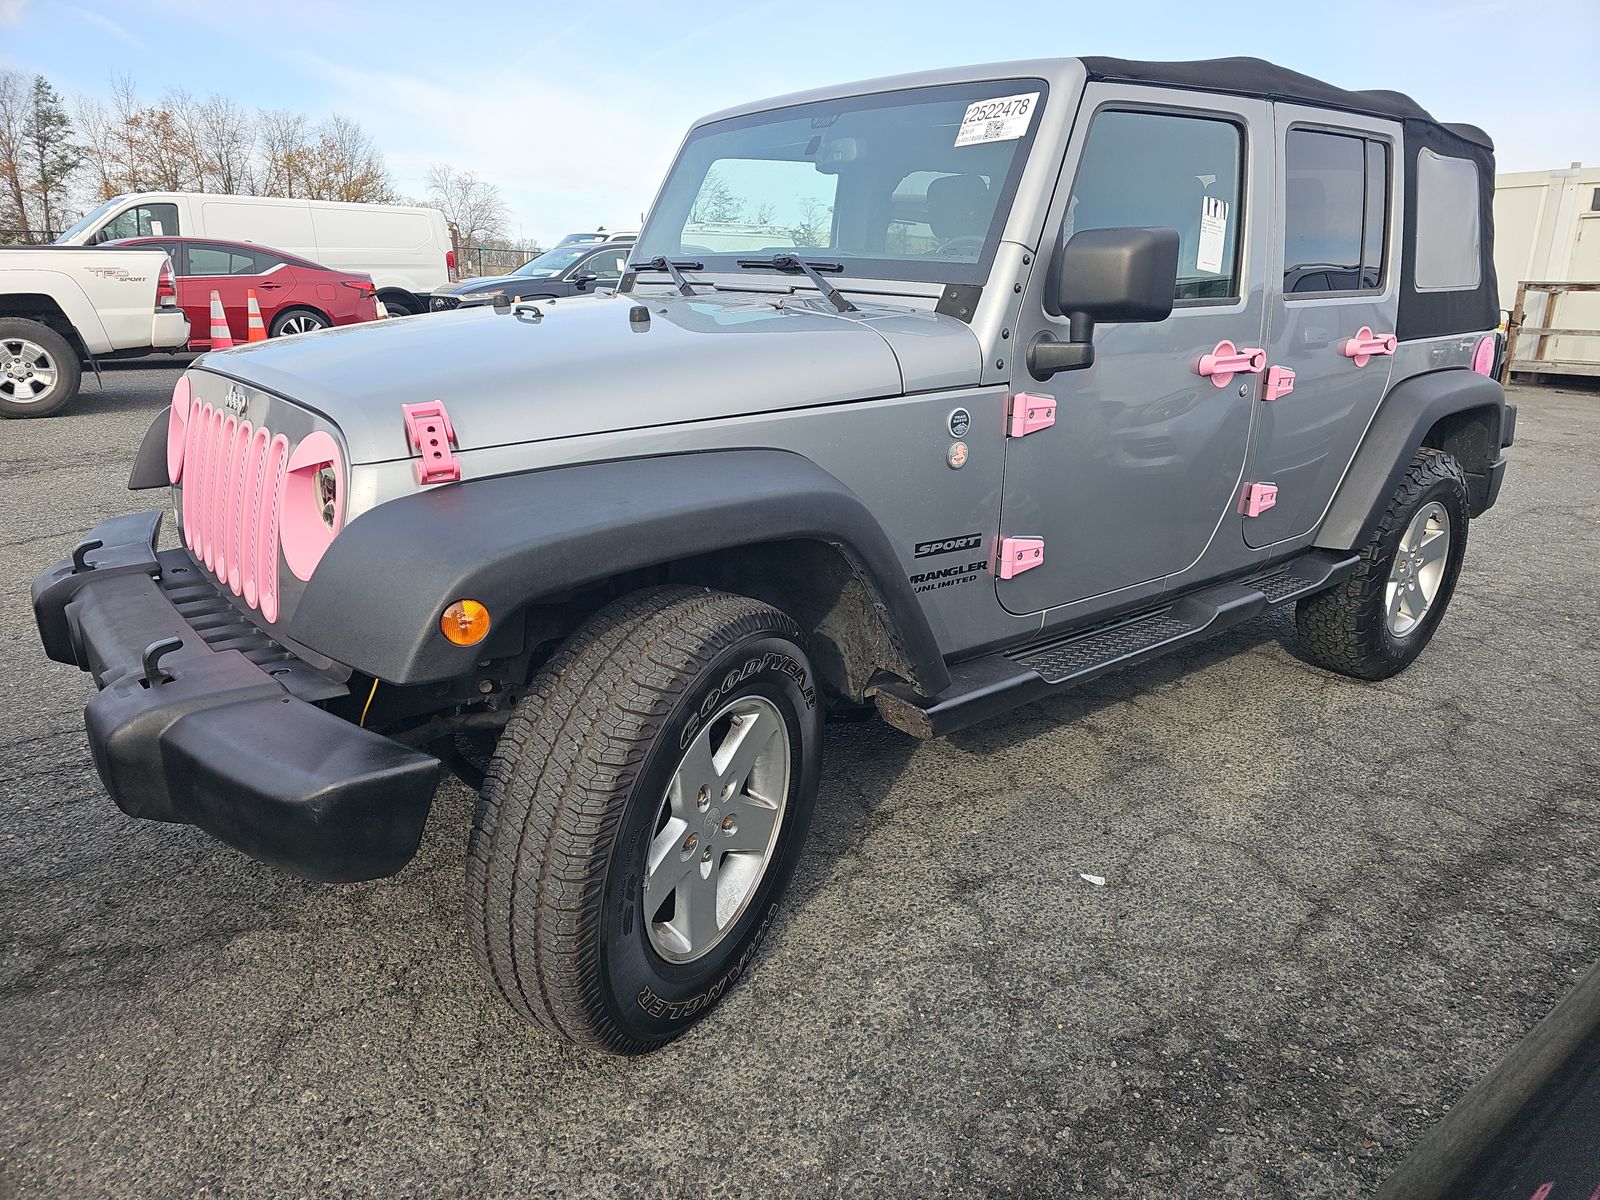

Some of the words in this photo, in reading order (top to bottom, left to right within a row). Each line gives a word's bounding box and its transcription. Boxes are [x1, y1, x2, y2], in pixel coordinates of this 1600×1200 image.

[89, 269, 129, 279] TRD
[914, 536, 982, 555] SPORT
[914, 574, 977, 593] UNLIMITED
[680, 652, 817, 750] GOODYEAR
[637, 902, 779, 1019] WRANGLER
